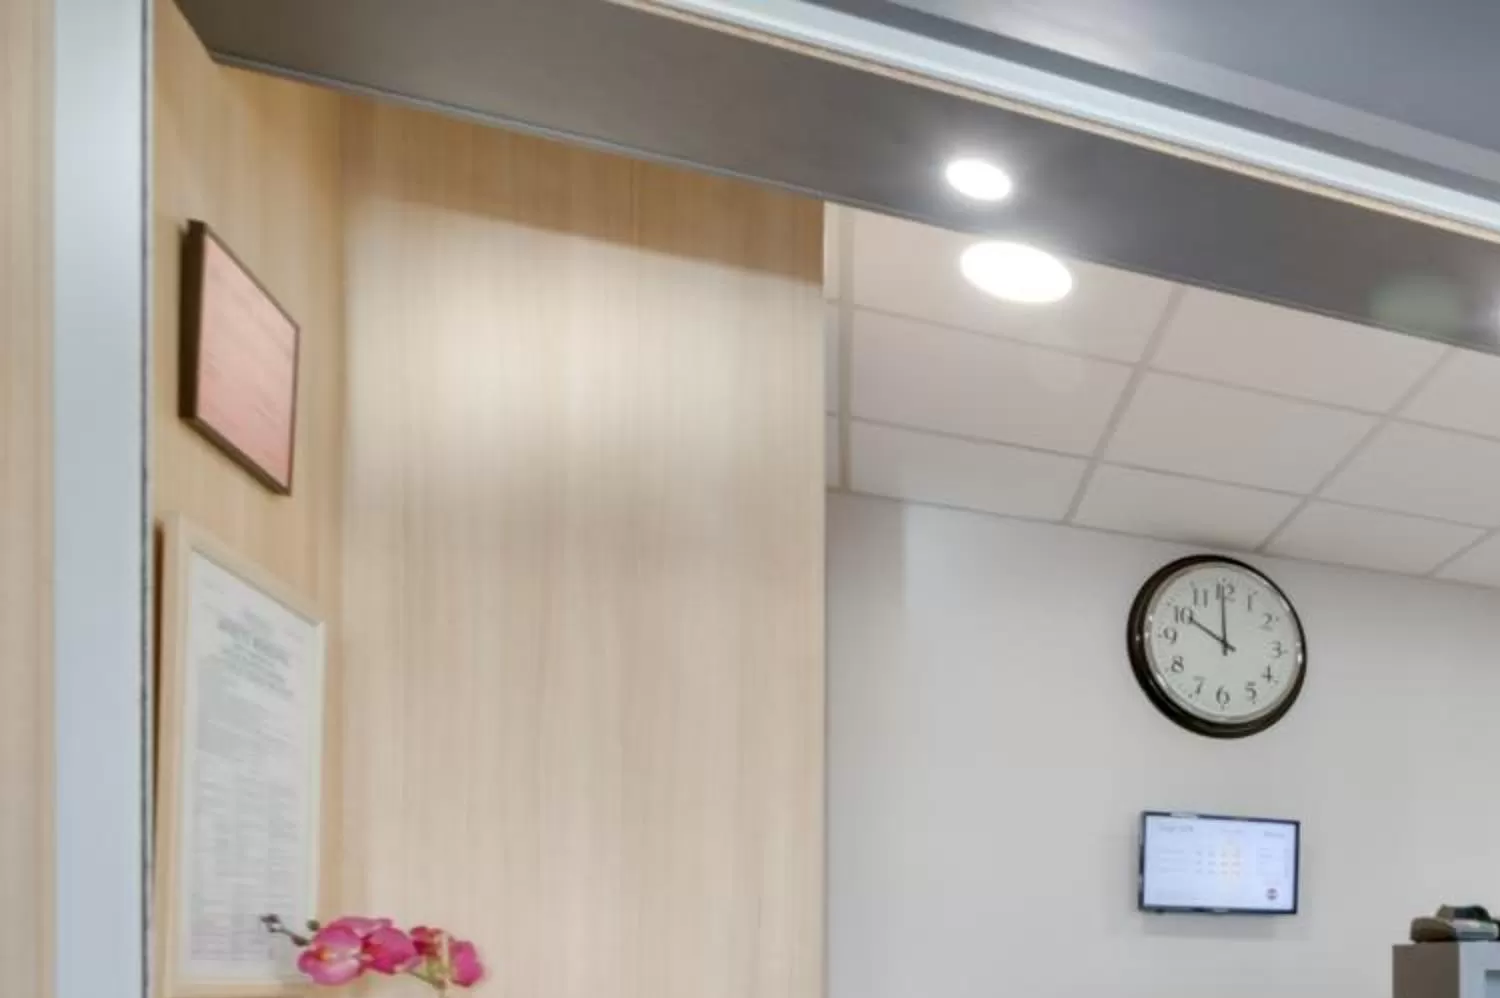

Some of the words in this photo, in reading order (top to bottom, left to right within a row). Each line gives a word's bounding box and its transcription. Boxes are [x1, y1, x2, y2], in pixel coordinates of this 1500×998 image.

[1193, 587, 1208, 608] 11
[1215, 583, 1236, 602] 12
[1247, 590, 1258, 612] 1
[1174, 605, 1193, 624] 10
[1261, 612, 1273, 630] 2
[1163, 627, 1177, 644] 9
[1271, 640, 1281, 658] 3
[1171, 655, 1184, 673] 8
[1261, 664, 1272, 682] 4
[1193, 675, 1205, 694] 7
[1245, 681, 1257, 700] 5
[1215, 686, 1230, 704] 6
